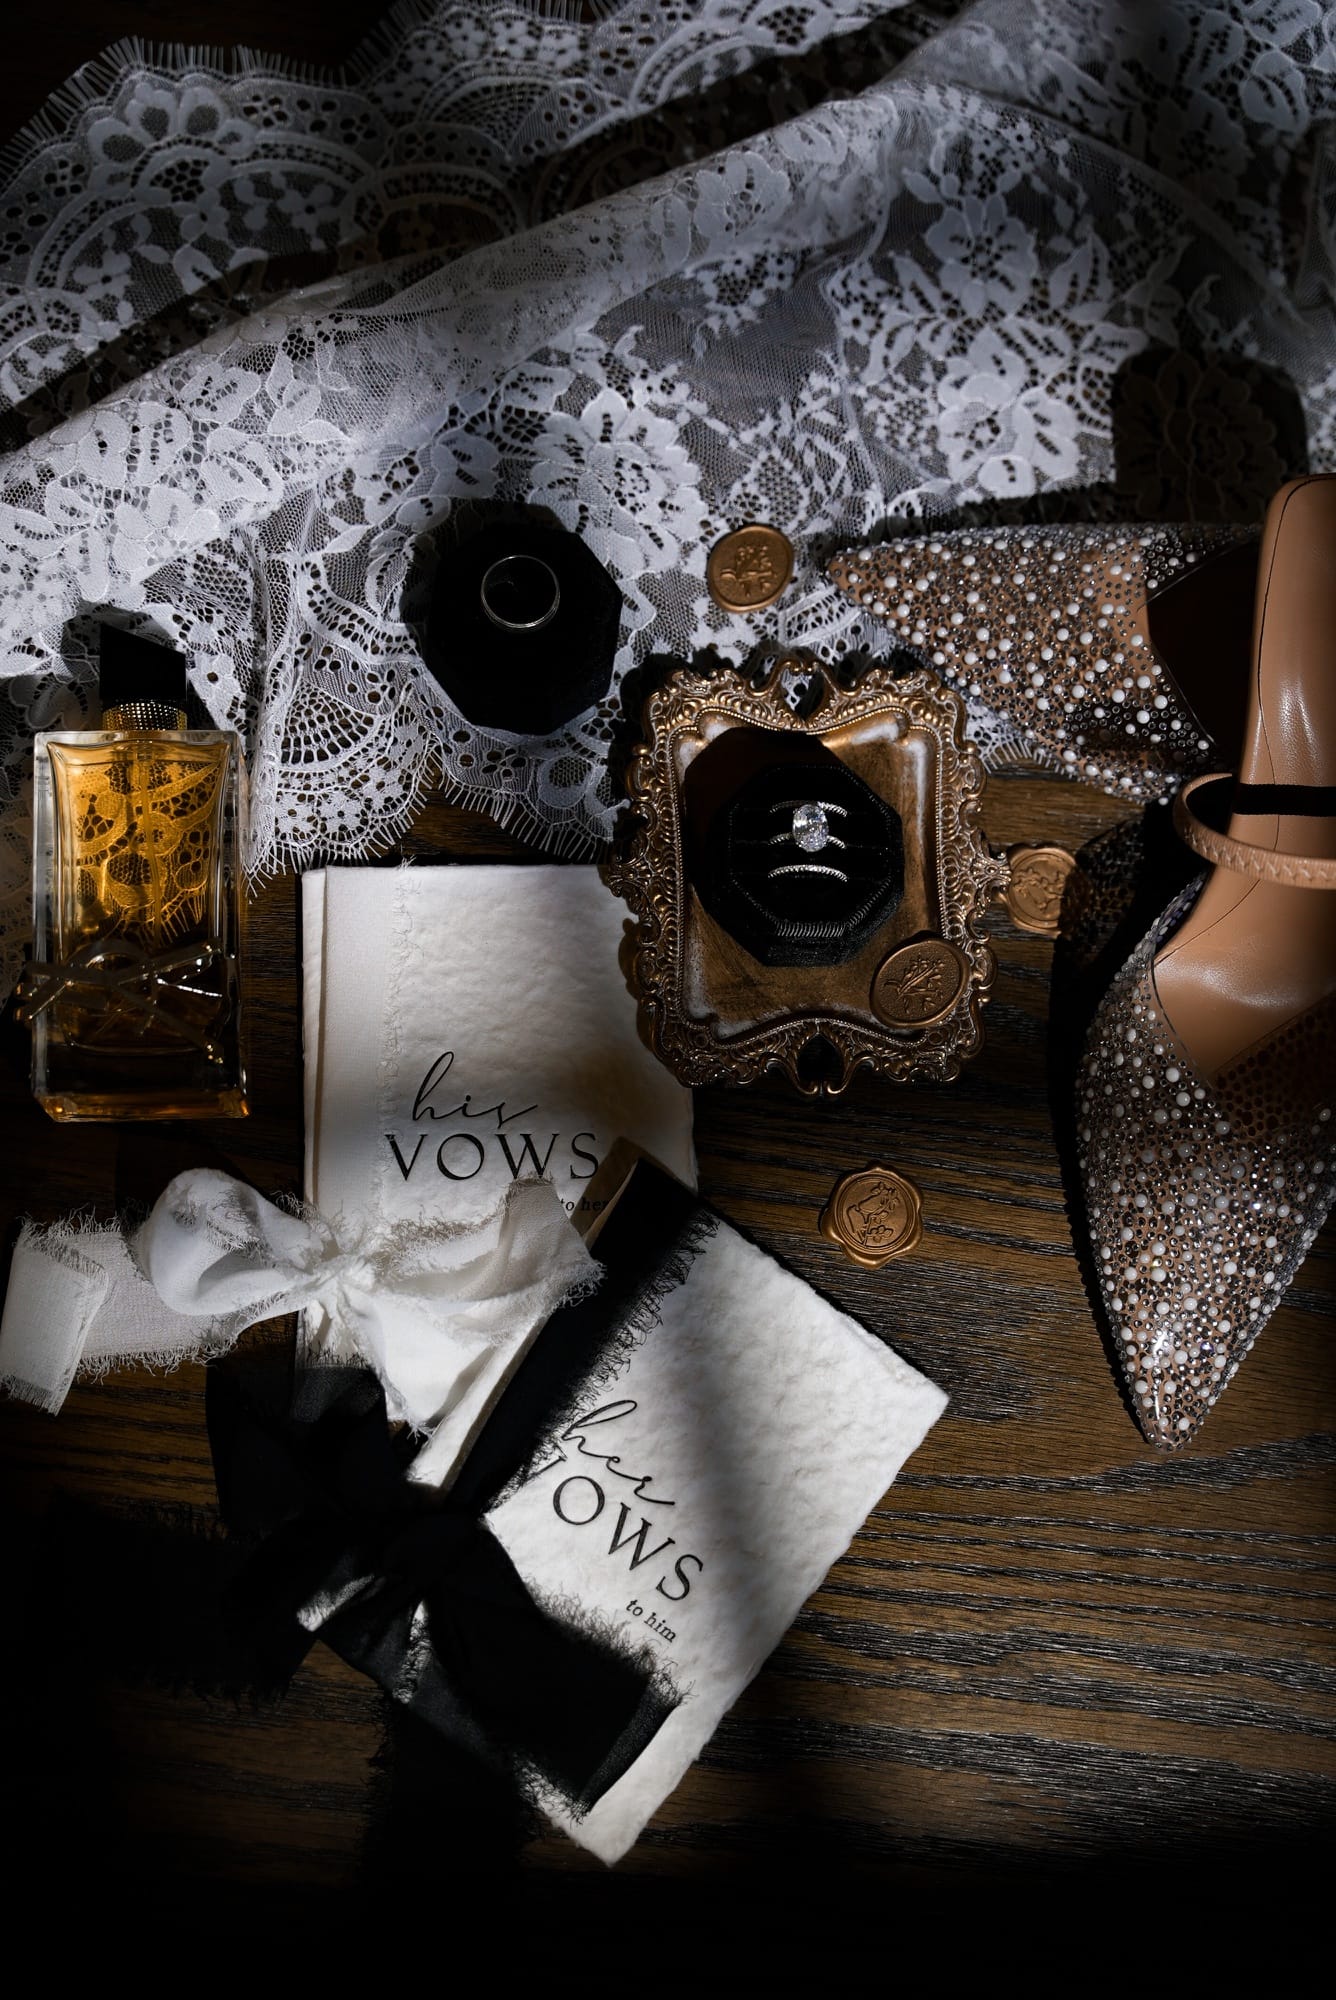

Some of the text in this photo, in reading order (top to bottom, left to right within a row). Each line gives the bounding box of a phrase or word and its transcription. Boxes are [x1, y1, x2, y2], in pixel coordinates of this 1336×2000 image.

[412, 1050, 538, 1129] his
[384, 1132, 600, 1181] VOWS
[561, 1399, 676, 1506] her
[625, 1598, 677, 1643] to him
